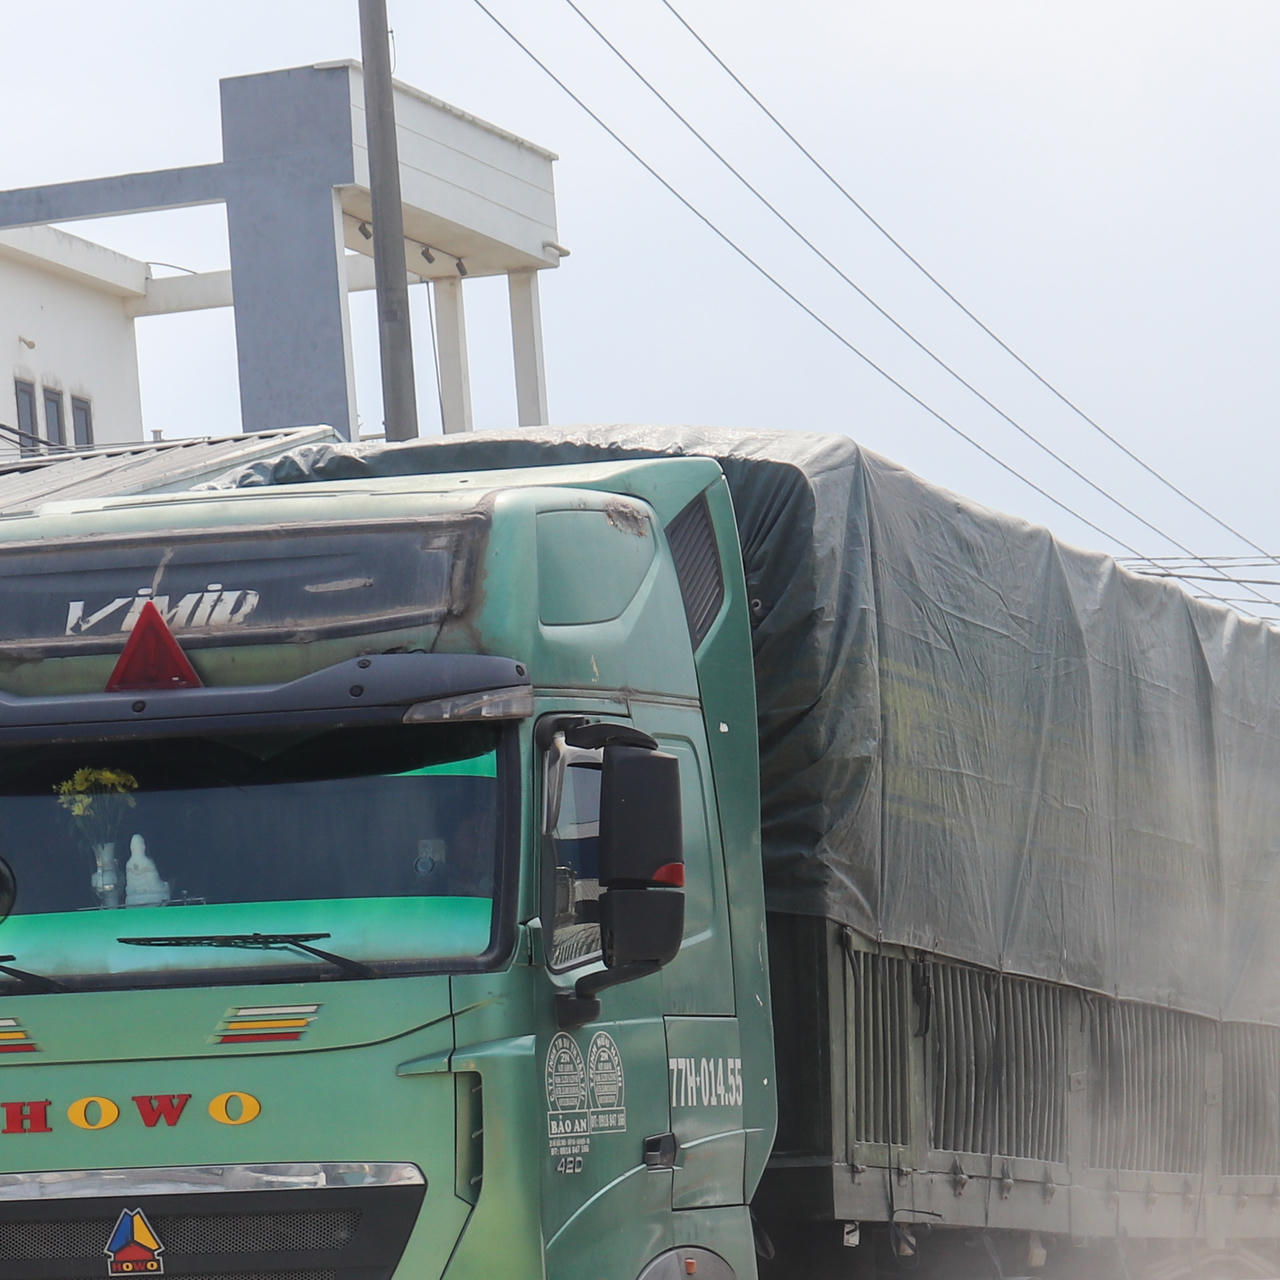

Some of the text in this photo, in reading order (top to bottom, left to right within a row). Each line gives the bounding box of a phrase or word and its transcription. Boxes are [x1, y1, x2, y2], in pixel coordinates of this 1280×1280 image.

[0, 1091, 262, 1134] HOWO
[550, 1115, 572, 1134] BẢO
[573, 1119, 587, 1132] AN
[111, 1261, 159, 1273] HOWO
